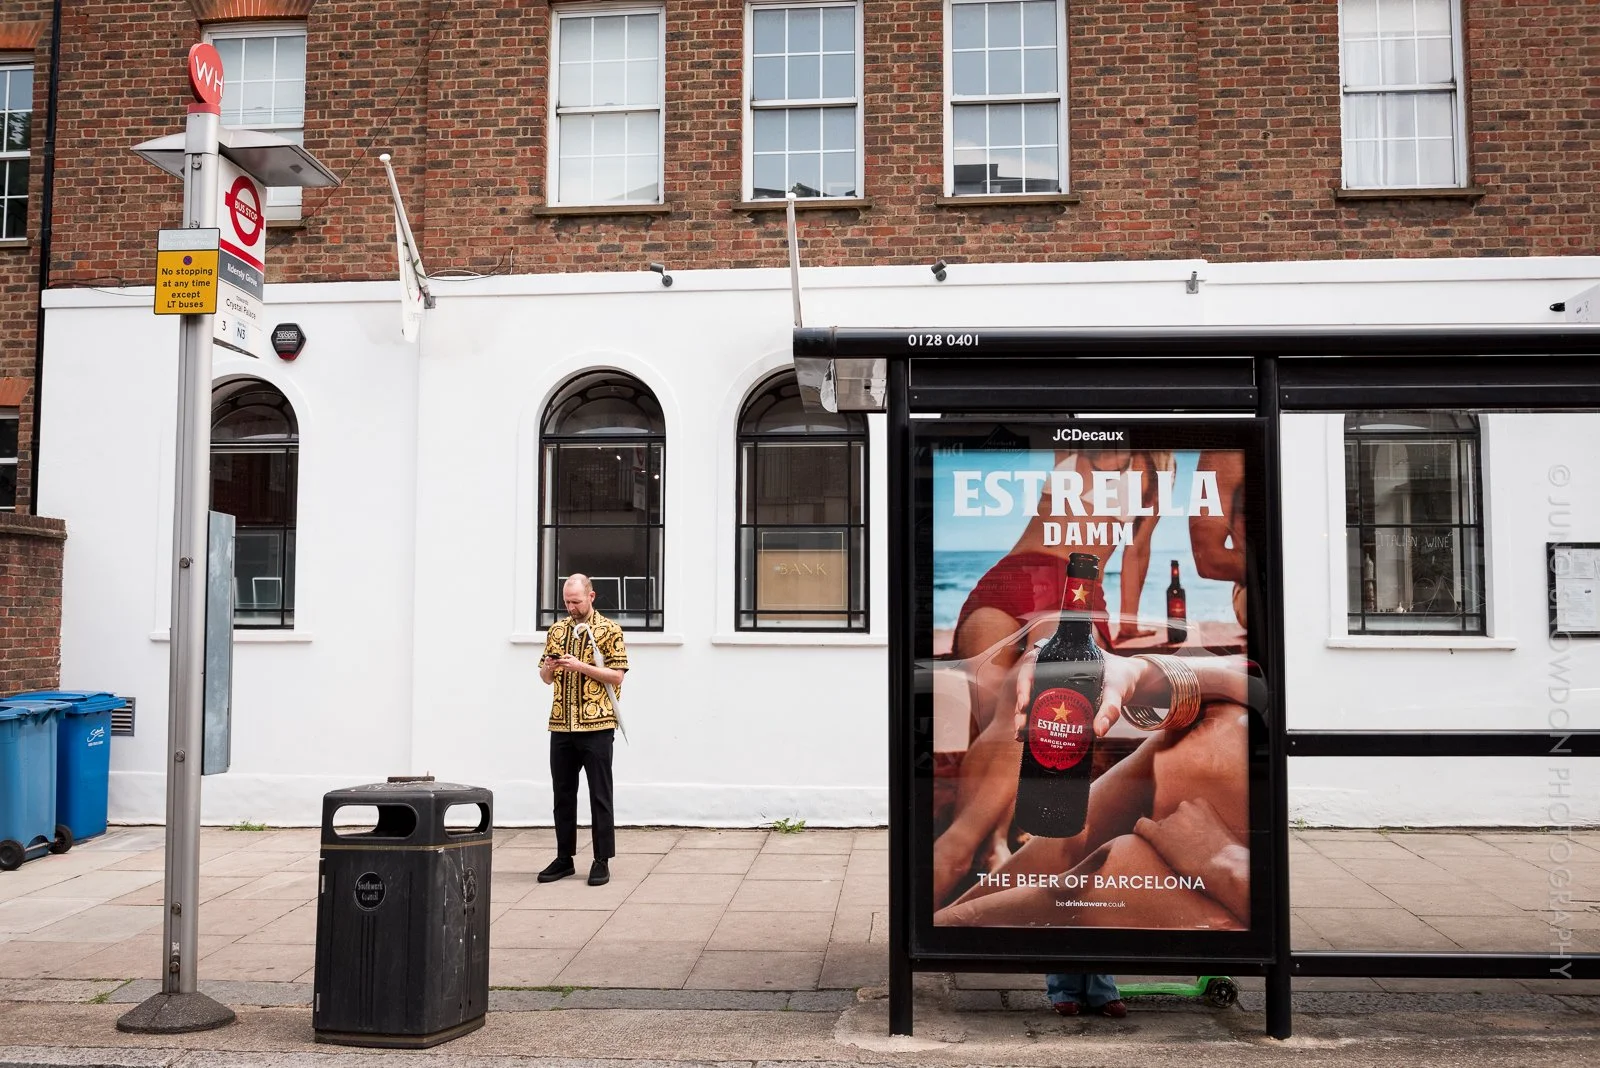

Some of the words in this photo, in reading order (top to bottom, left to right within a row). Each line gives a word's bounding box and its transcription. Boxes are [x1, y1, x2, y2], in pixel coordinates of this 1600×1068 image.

[195, 55, 224, 98] WH
[234, 200, 246, 213] BUS
[246, 206, 258, 221] STOP
[175, 267, 213, 276] stopping
[245, 273, 258, 287] Grove
[171, 291, 201, 299] except
[178, 300, 204, 308] buses
[226, 298, 242, 312] Crystal
[221, 320, 227, 331] 3
[236, 327, 246, 340] N3
[908, 334, 943, 346] 0128
[946, 334, 979, 346] 0401
[1052, 428, 1124, 442] JCDecaux
[952, 470, 1224, 517] ESTRELLA
[1042, 522, 1135, 547] DAMM
[779, 563, 828, 576] BANK
[1037, 718, 1083, 734] ESTRELLA
[1040, 737, 1076, 747] BARCELONA
[976, 873, 1011, 887] THE
[1016, 873, 1060, 888] BEER
[1064, 874, 1089, 889] OF
[1094, 875, 1206, 890] BARCELONA
